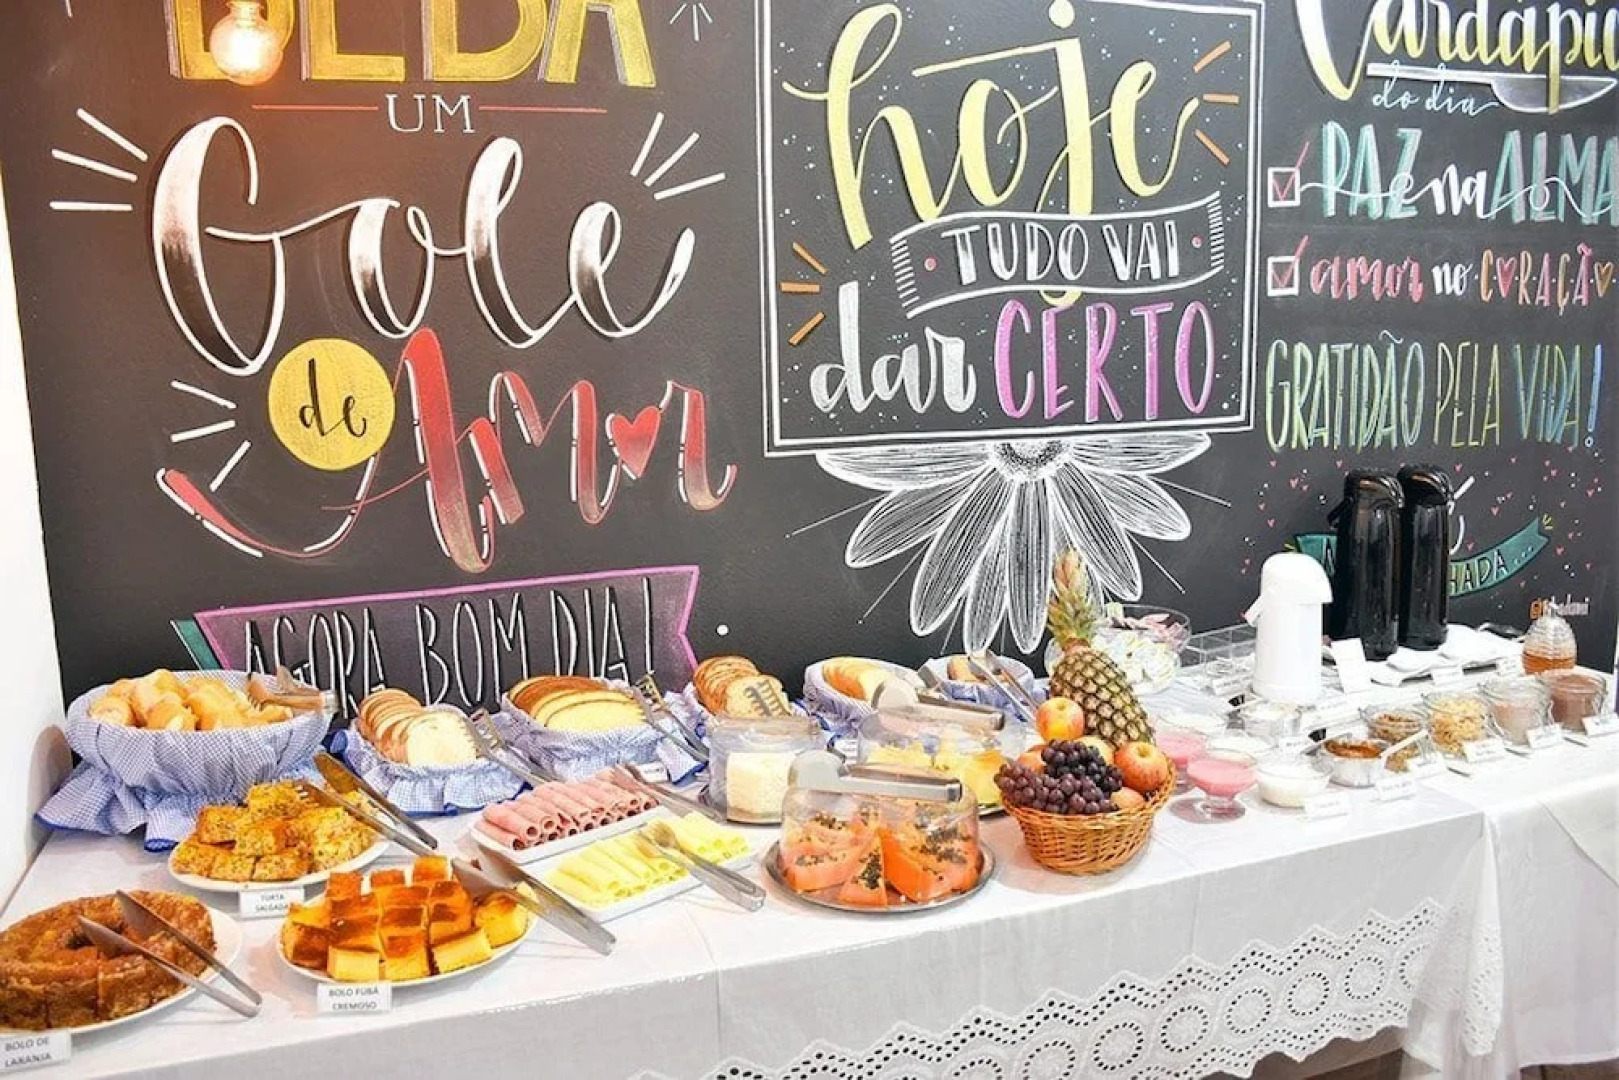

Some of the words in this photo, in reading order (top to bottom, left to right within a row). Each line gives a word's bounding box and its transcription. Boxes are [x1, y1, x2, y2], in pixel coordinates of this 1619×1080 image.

[387, 94, 475, 134] UM
[1372, 60, 1420, 108] do
[1425, 62, 1500, 117] dia
[783, 0, 1199, 306] hoje
[1321, 120, 1422, 220] PAZ
[1430, 164, 1487, 218] na
[151, 117, 696, 376] Gole
[941, 222, 1089, 286] TUDO
[1102, 220, 1180, 282] VAI
[1310, 256, 1423, 302] amor
[1431, 259, 1474, 295] no
[809, 280, 977, 414] dar
[993, 299, 1215, 424] CERTO
[299, 357, 366, 438] de
[1264, 330, 1426, 453] GRATIDÃO
[1433, 341, 1500, 448] PELA
[1512, 342, 1603, 448] VIDA!
[244, 607, 386, 719] AGORA
[414, 591, 529, 706] BOM
[550, 576, 655, 686] DIA!
[328, 987, 353, 997] BOLO
[355, 984, 380, 995] FUBÁ
[332, 1001, 377, 1011] CREMOSO
[4, 1038, 35, 1052] BOLO
[36, 1036, 49, 1047] DE
[4, 1052, 53, 1068] LARANJA
